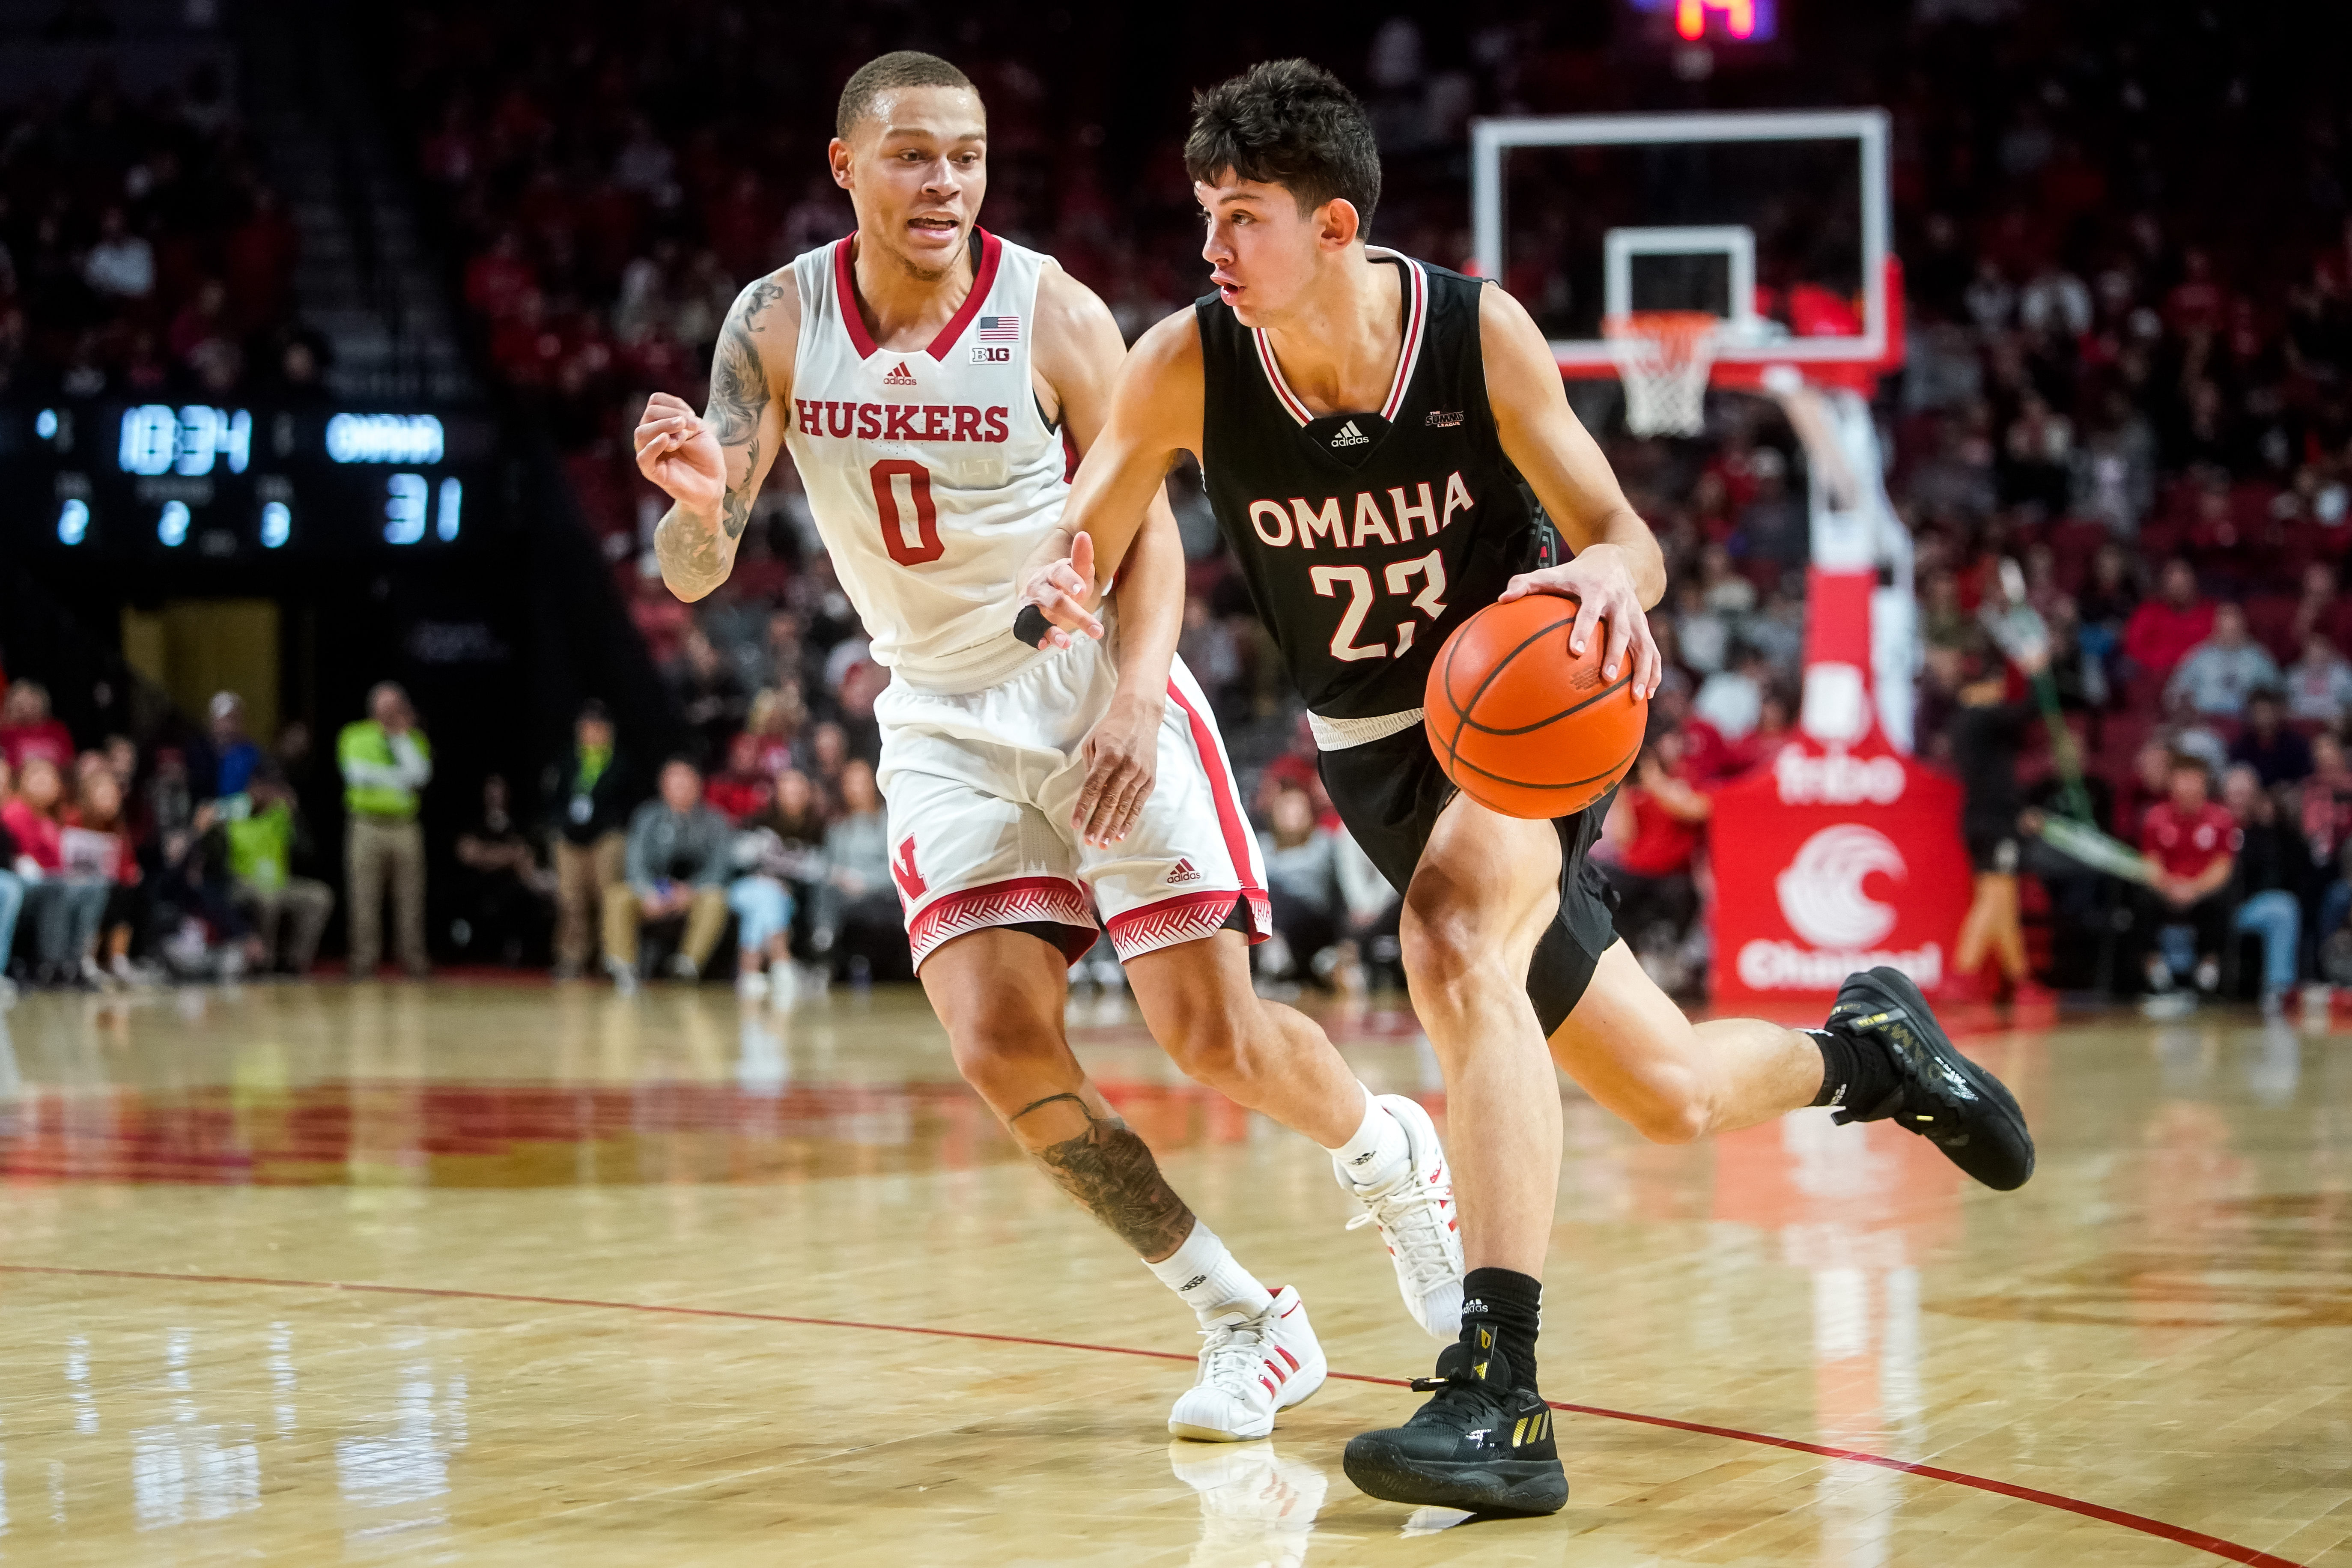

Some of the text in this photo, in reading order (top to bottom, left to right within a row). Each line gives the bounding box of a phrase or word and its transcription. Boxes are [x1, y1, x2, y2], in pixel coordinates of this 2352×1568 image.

[883, 377, 917, 385] adidas
[795, 399, 1009, 443] HUSKERS
[1331, 436, 1369, 447] adidas
[870, 459, 945, 566] 0
[1249, 471, 1475, 550] OMAHA
[1309, 548, 1448, 662] 23
[1167, 872, 1201, 883] adidas
